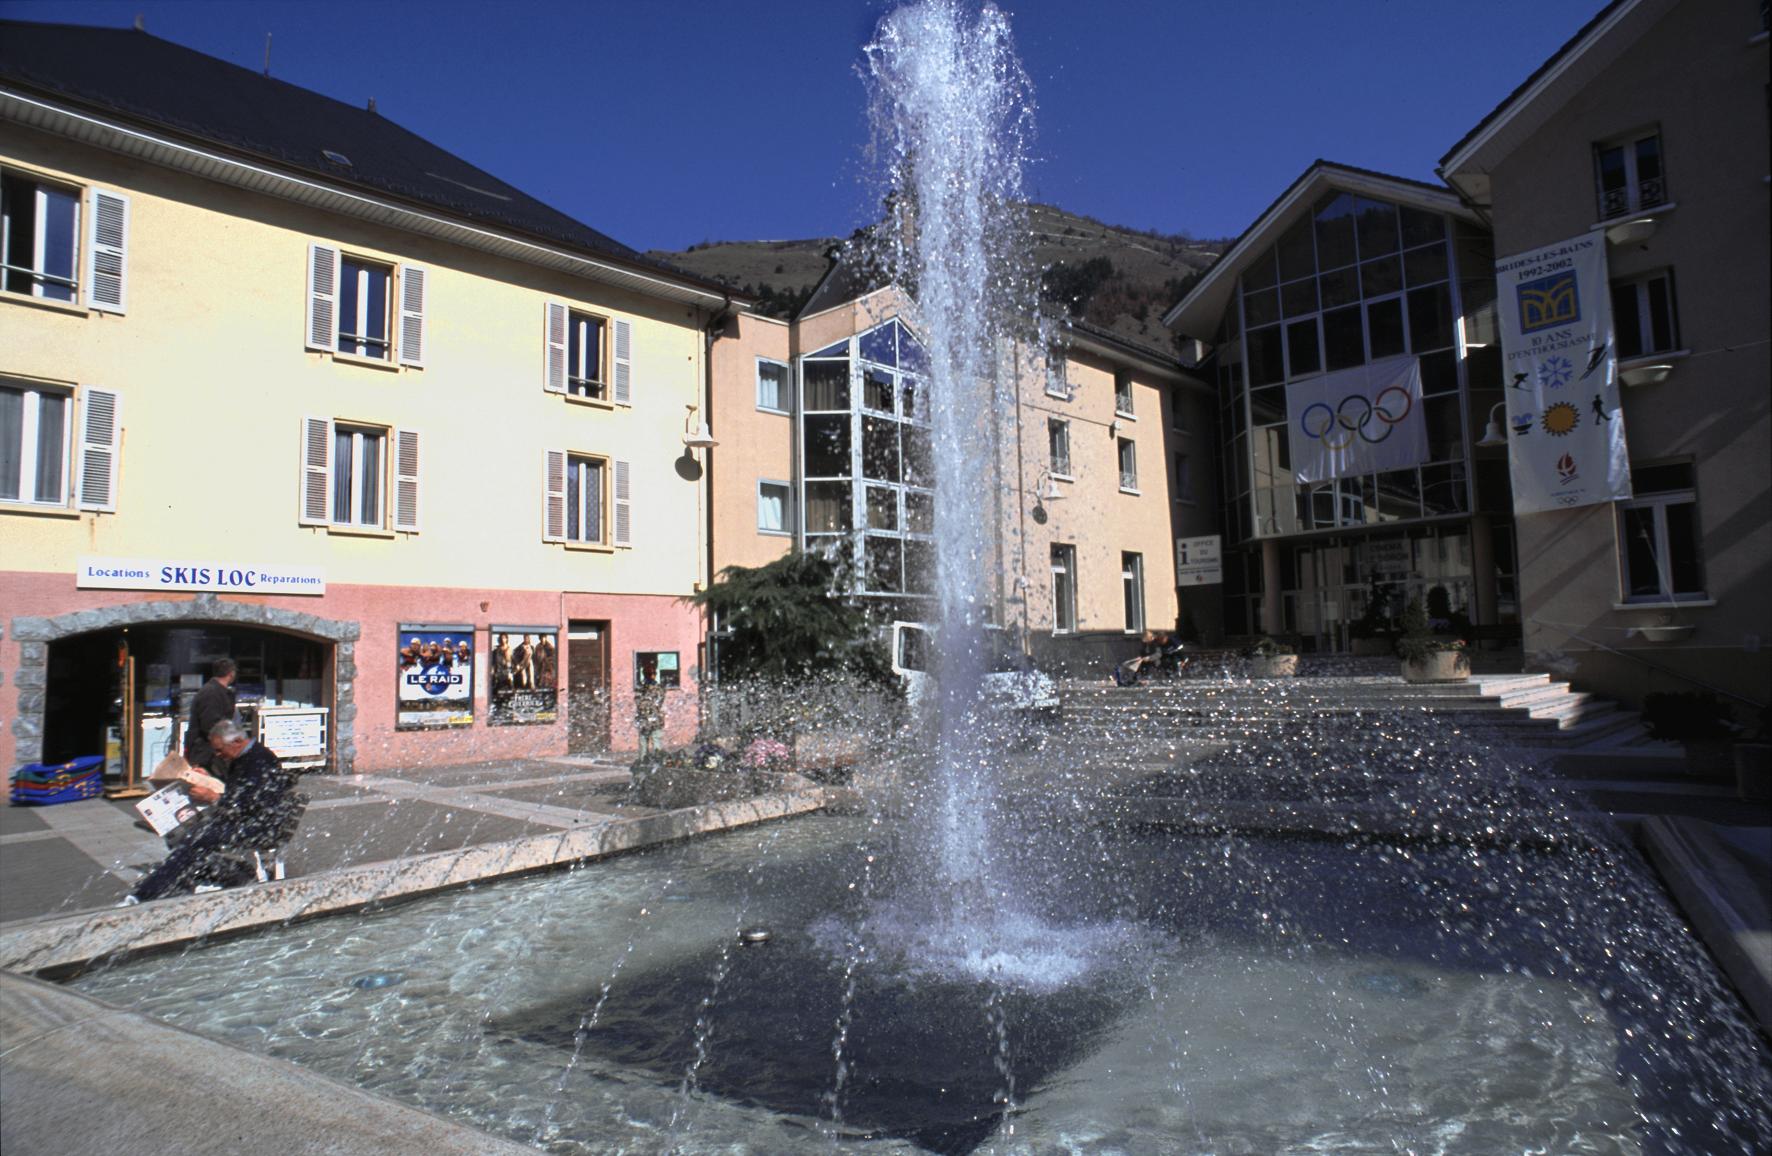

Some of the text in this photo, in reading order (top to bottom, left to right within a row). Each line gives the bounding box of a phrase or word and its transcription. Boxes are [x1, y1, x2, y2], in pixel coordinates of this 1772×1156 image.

[1496, 240, 1593, 273] BRIDES-LES-BAINS
[1518, 258, 1573, 280] 1992-2002
[1532, 329, 1573, 346] 10 ANS
[88, 566, 321, 586] Locations SKIS LOC Reparations
[410, 675, 460, 684] LE RAID
